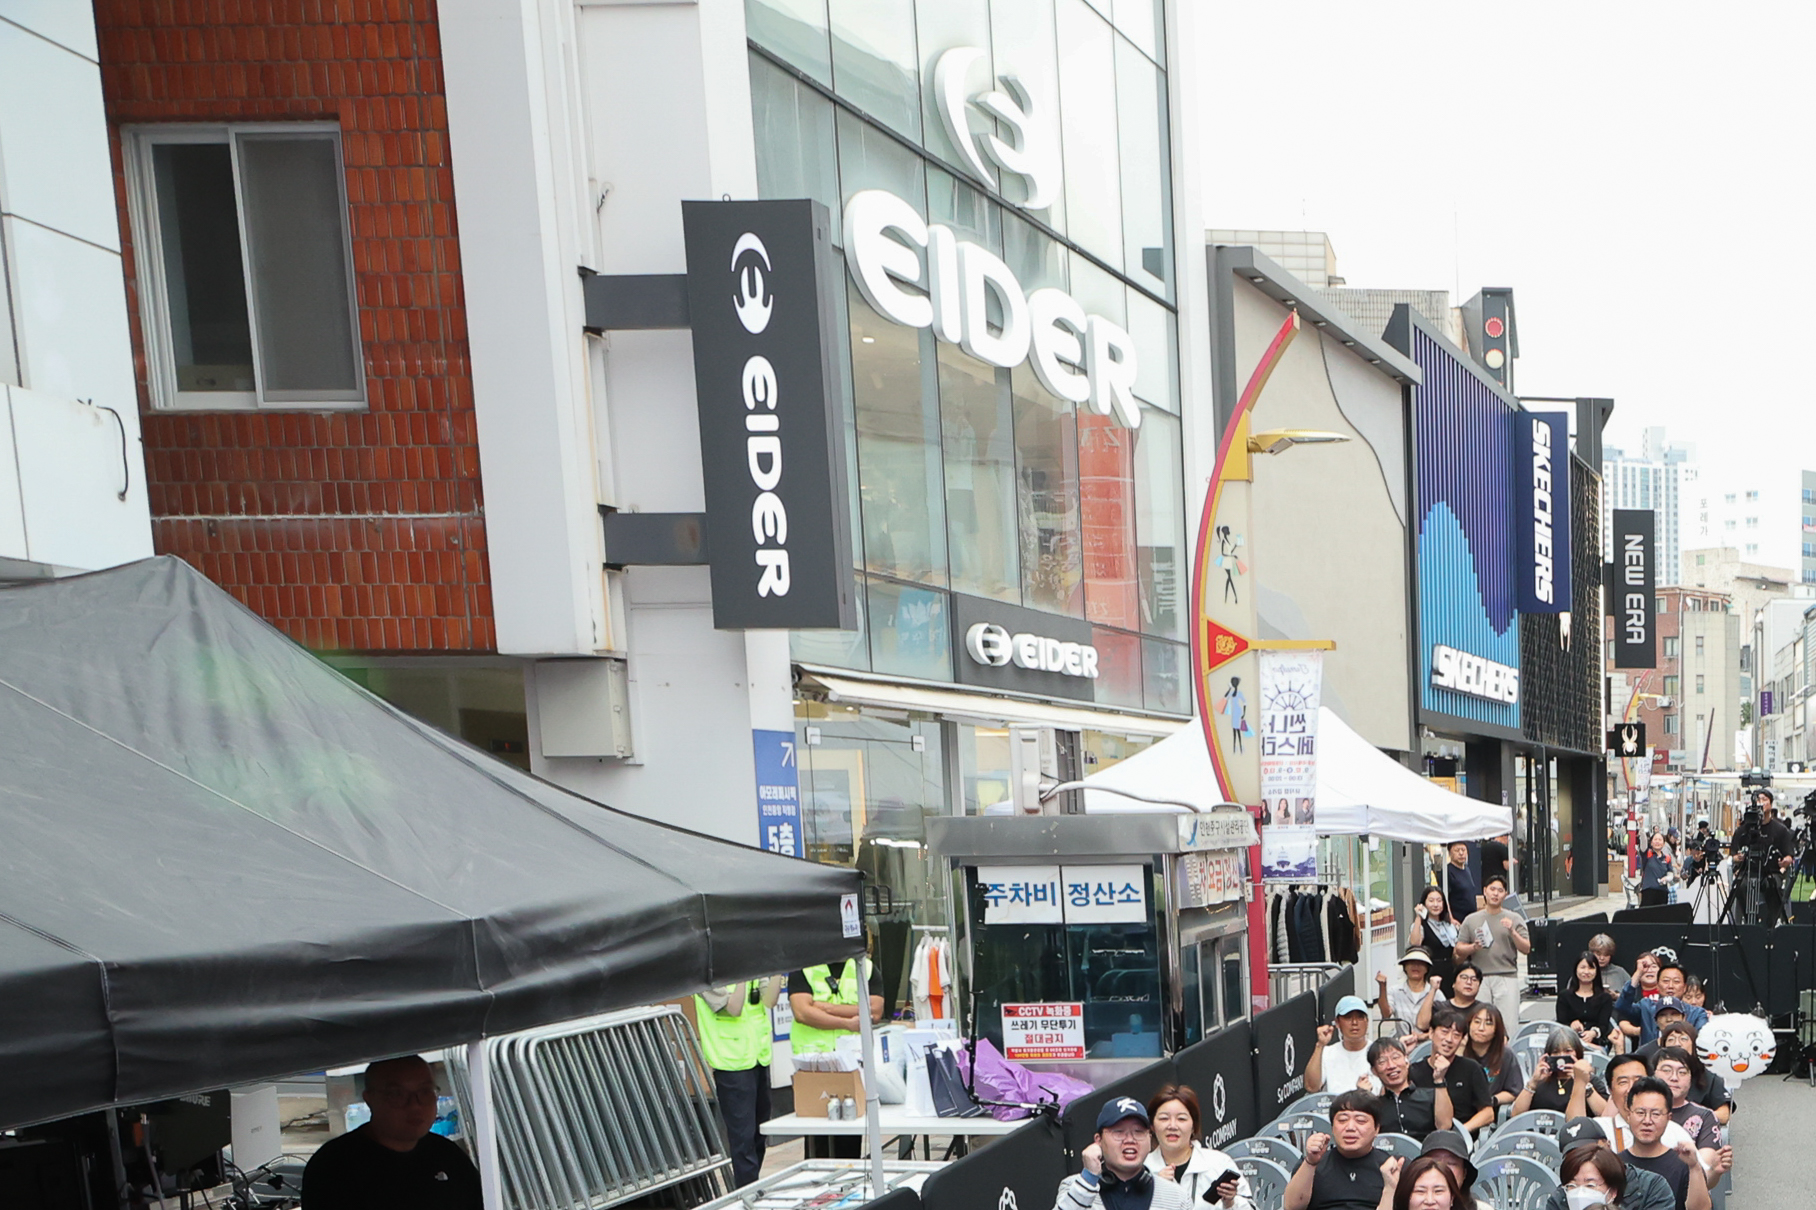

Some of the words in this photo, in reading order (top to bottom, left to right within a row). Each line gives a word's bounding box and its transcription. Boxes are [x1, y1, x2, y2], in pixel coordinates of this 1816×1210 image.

[843, 190, 1141, 429] EIDER
[741, 355, 791, 599] EIDER
[1531, 419, 1553, 605] SKECHERS
[1624, 533, 1644, 587] NEW
[1625, 592, 1645, 645] ERA
[1011, 637, 1099, 678] EIDER
[1435, 645, 1519, 705] SKECHERS
[767, 822, 795, 857] 5층
[984, 881, 1056, 907] 주차비
[1068, 881, 1142, 907] 정산소
[1011, 1019, 1038, 1031] 쓰레기
[1040, 1019, 1076, 1030] 무단투기
[1018, 1006, 1044, 1016] CCTV
[1025, 1033, 1064, 1044] 절대금지
[1211, 1117, 1238, 1148] COMPANY
